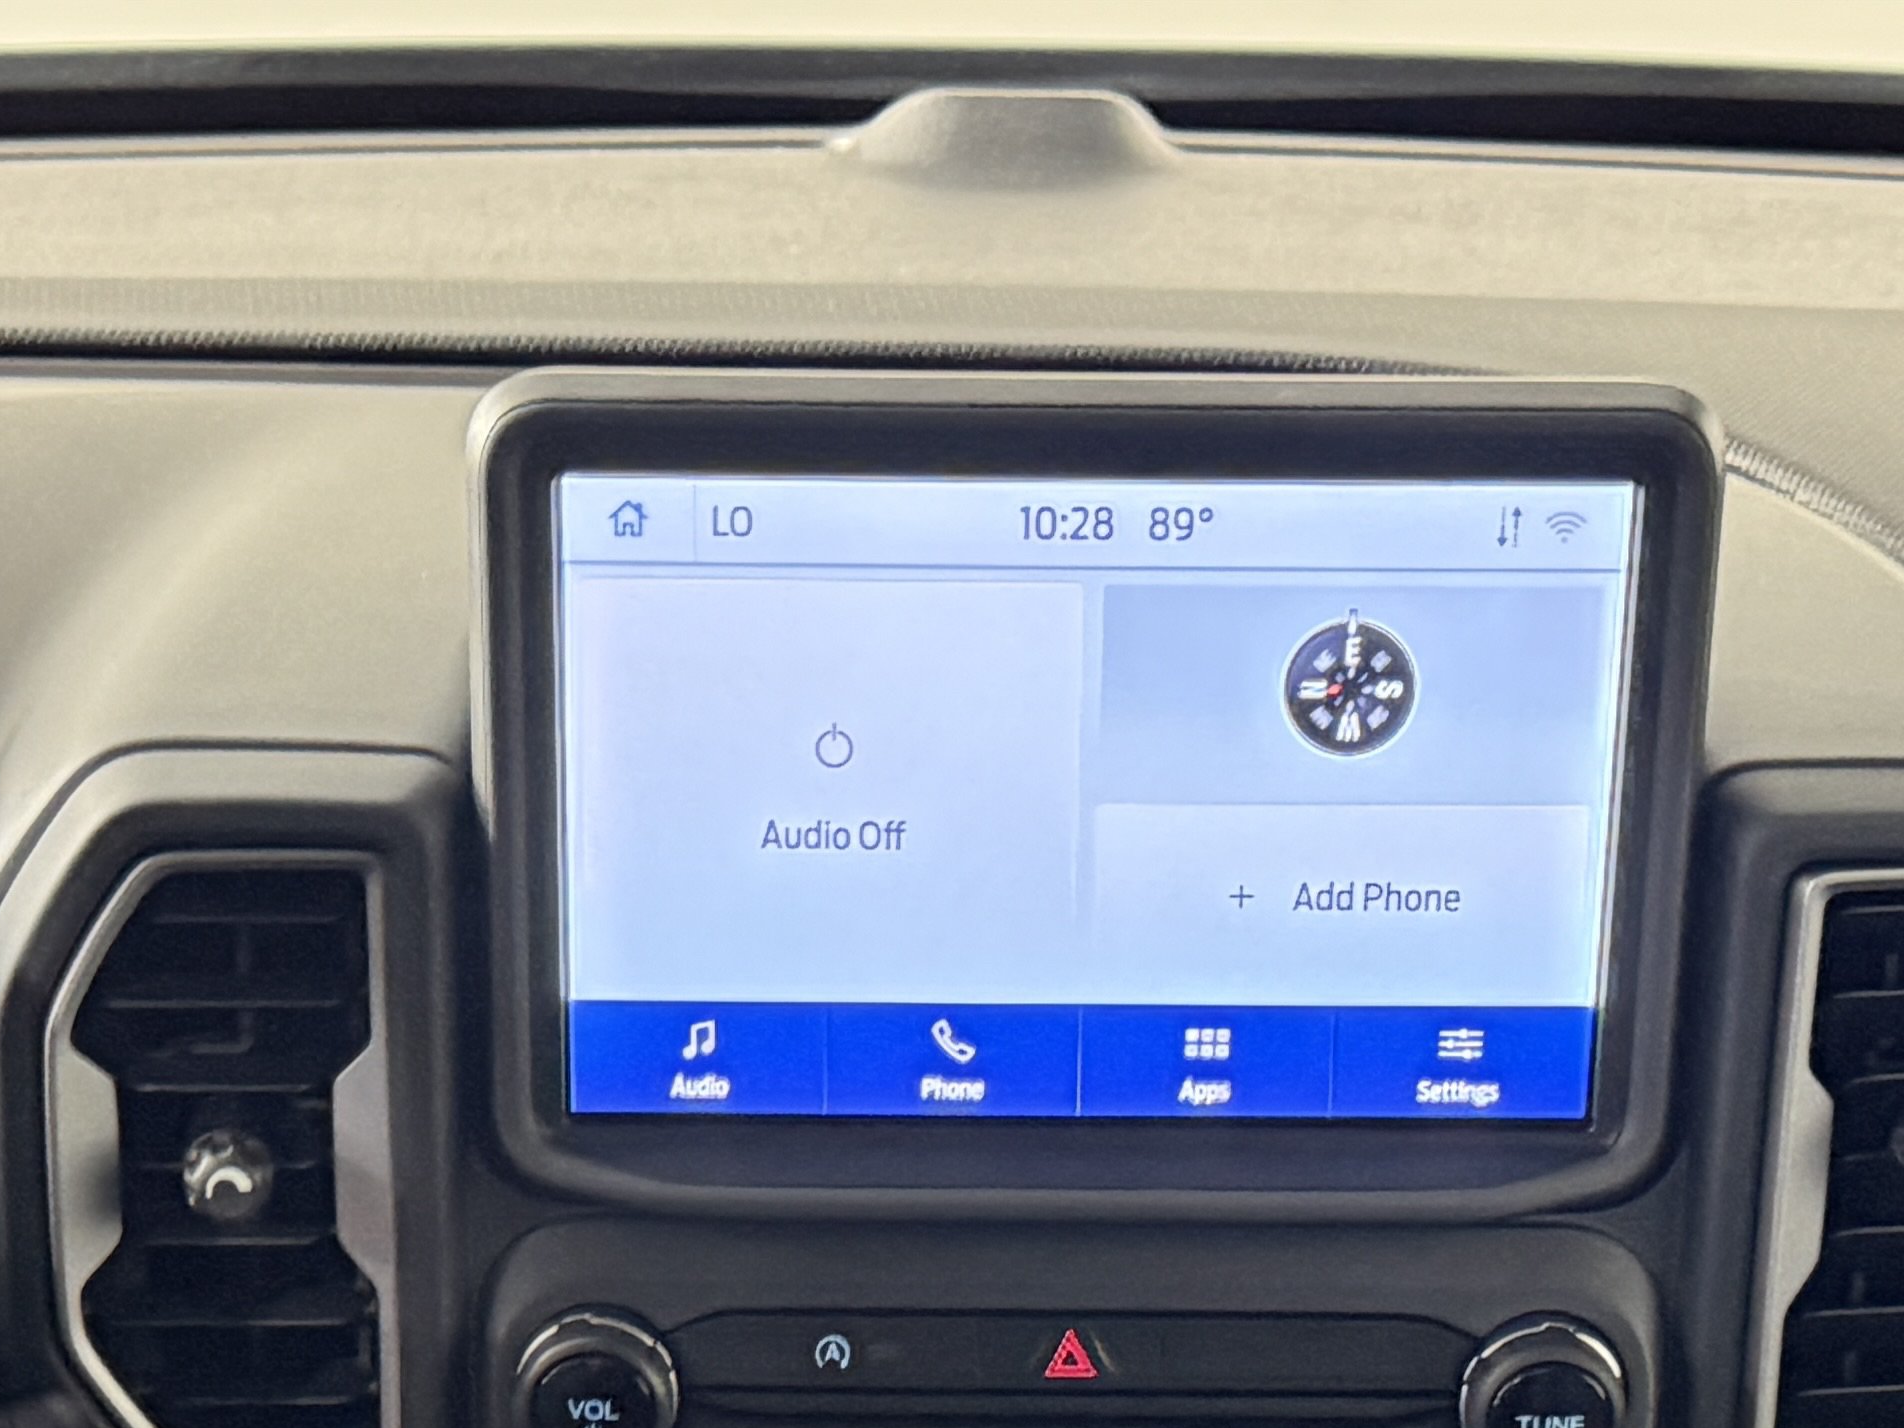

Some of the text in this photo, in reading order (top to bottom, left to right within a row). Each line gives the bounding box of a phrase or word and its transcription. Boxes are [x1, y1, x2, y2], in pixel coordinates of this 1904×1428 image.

[1021, 505, 1214, 541] 10:28 89°
[761, 820, 906, 850] Audio Off
[1293, 882, 1461, 912] Add Phone
[669, 1072, 730, 1100] Audio
[920, 1075, 985, 1101] Phone
[1178, 1076, 1231, 1105] Apps
[1416, 1078, 1500, 1107] Settings
[568, 1399, 619, 1421] VOL
